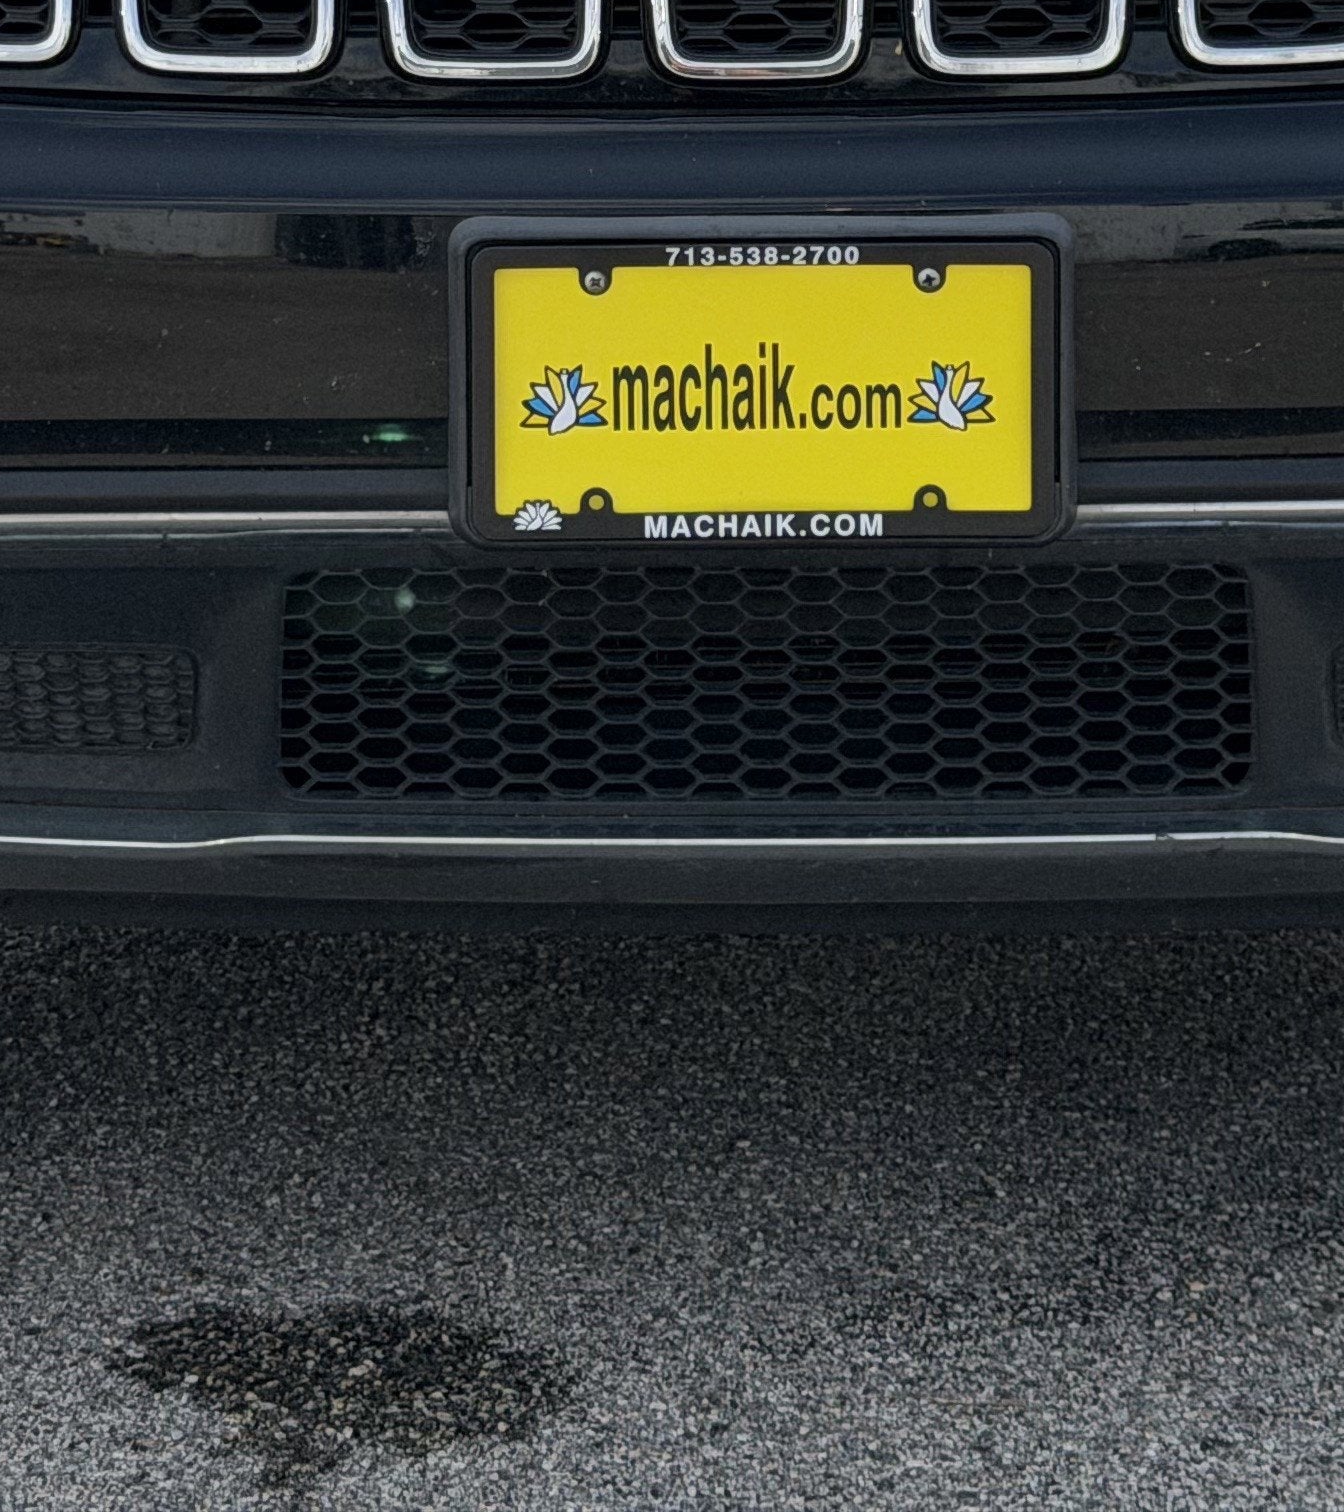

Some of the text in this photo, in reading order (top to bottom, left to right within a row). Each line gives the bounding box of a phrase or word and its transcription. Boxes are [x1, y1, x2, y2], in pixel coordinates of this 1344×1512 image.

[665, 245, 860, 266] 713-538-2700
[612, 342, 902, 431] machaik.com
[644, 513, 883, 538] MACHAIK.COM
